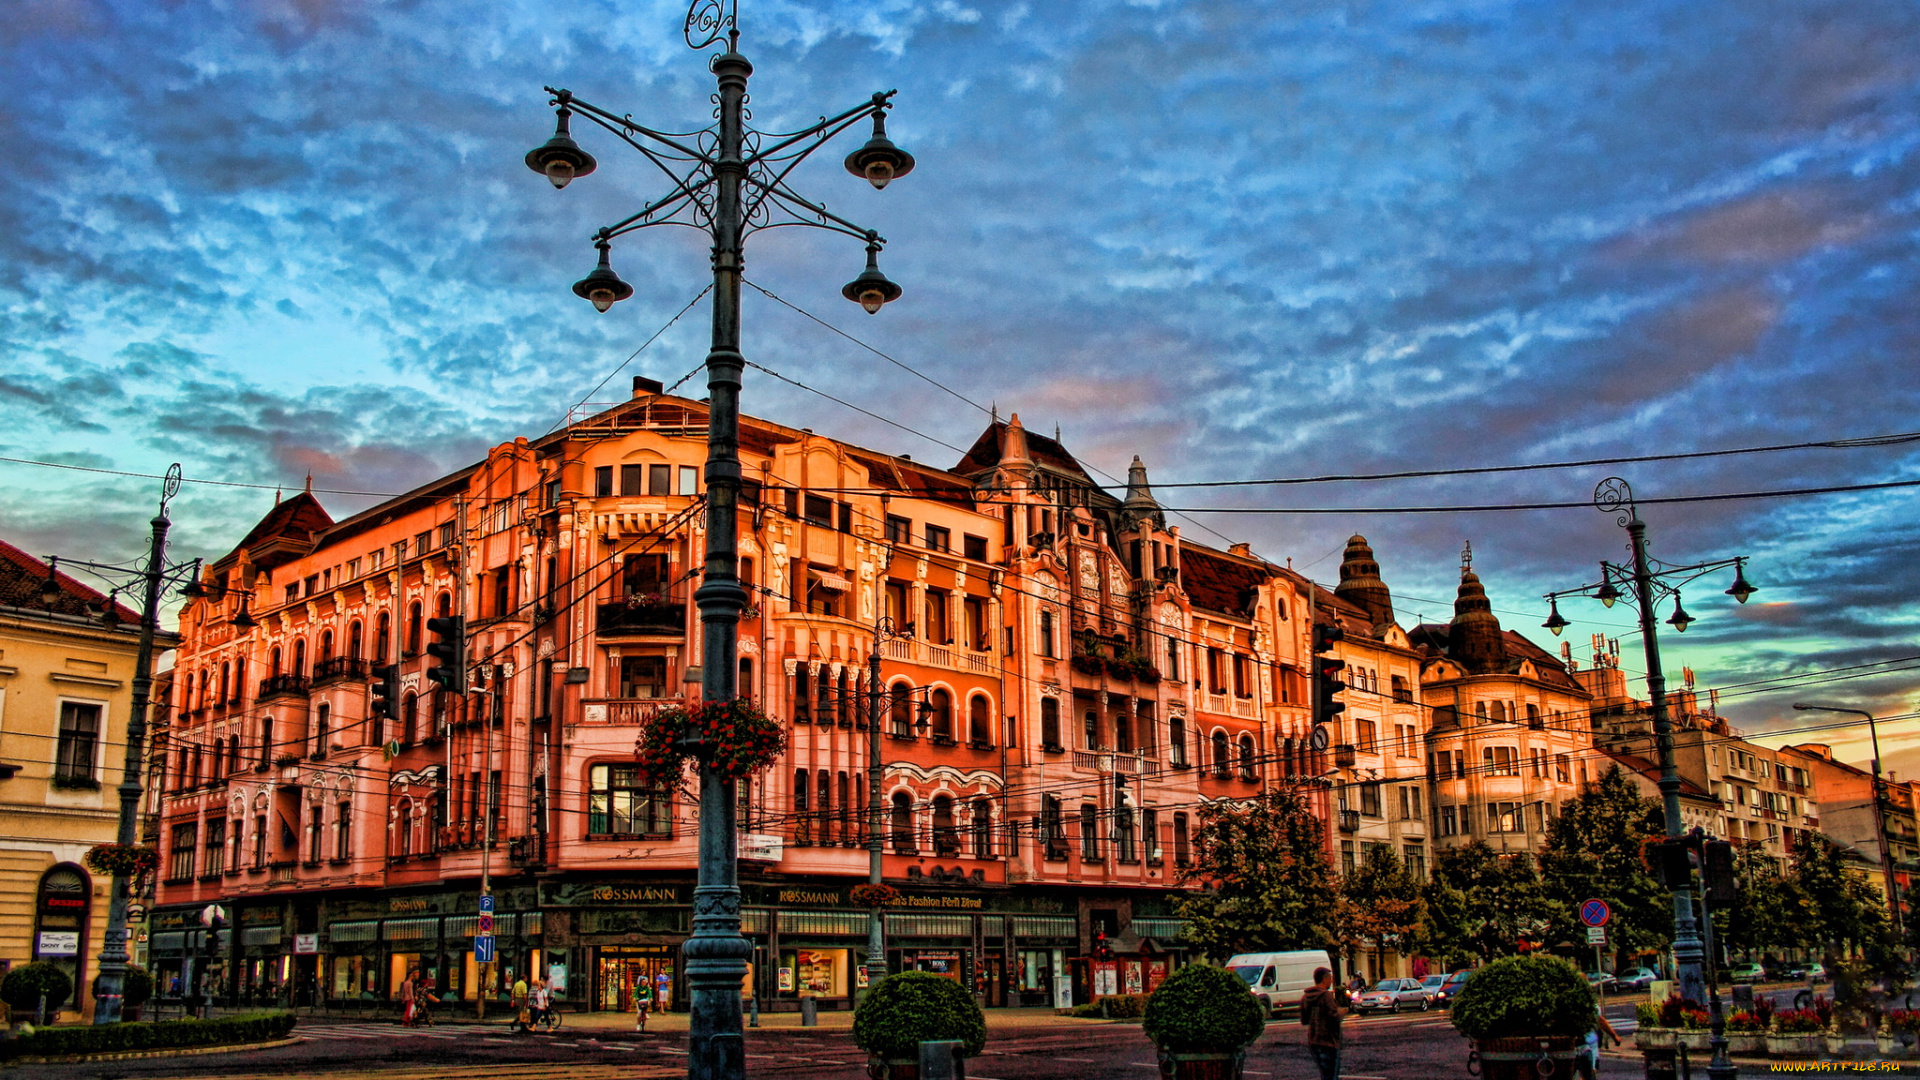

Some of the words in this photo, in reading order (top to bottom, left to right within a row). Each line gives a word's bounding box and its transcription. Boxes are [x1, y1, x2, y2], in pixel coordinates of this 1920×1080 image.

[592, 888, 676, 900] ROSSMANN
[779, 890, 839, 904] ROSSMANN
[908, 895, 940, 907] Fashion
[960, 897, 982, 909] Divat
